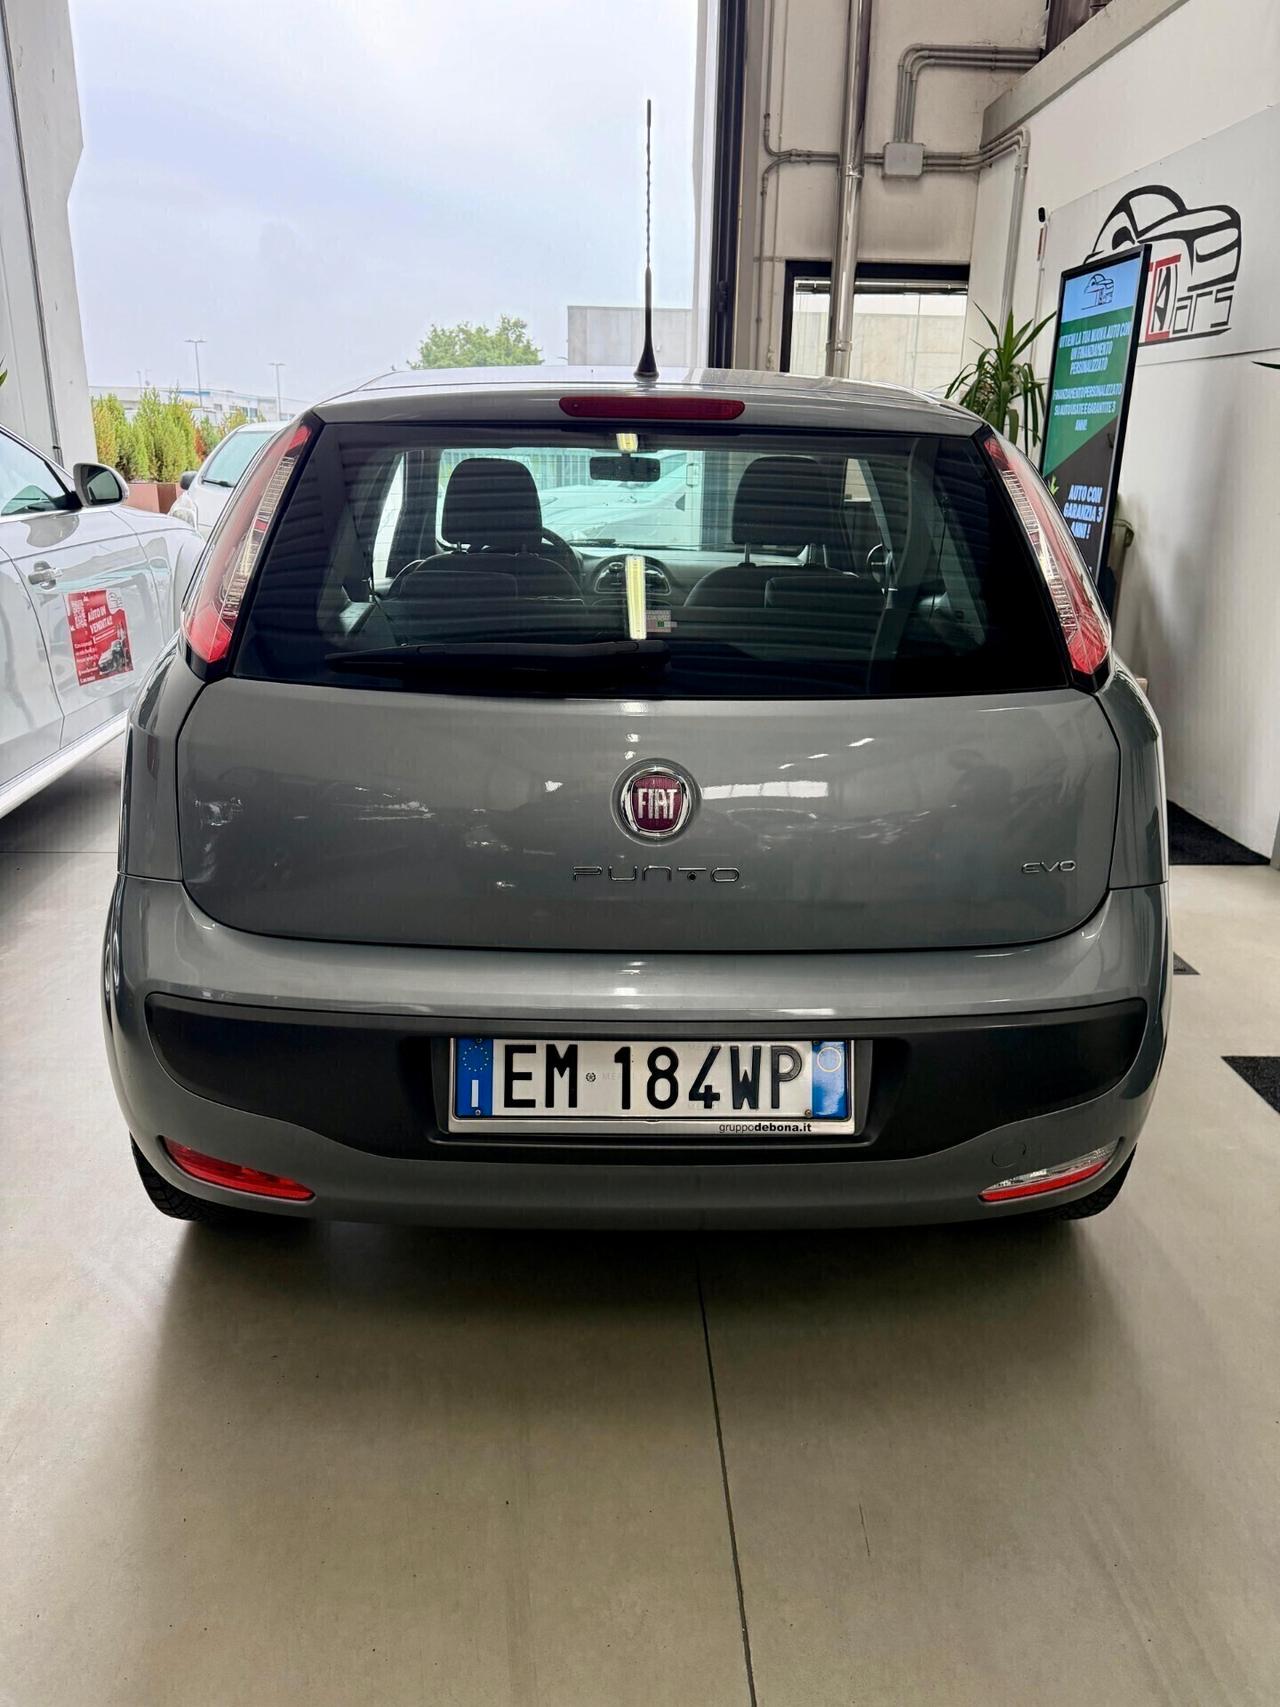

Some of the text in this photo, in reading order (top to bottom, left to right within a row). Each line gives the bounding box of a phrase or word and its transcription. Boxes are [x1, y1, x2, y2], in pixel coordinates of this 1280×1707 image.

[1068, 484, 1103, 504] AUTO CON
[1063, 502, 1097, 522] GARANZIA
[637, 788, 678, 819] FIAT
[572, 865, 740, 882] PUNTO
[1021, 860, 1077, 874] EVO
[503, 1044, 578, 1109] EM
[719, 1122, 812, 1133] gruppodebona.it
